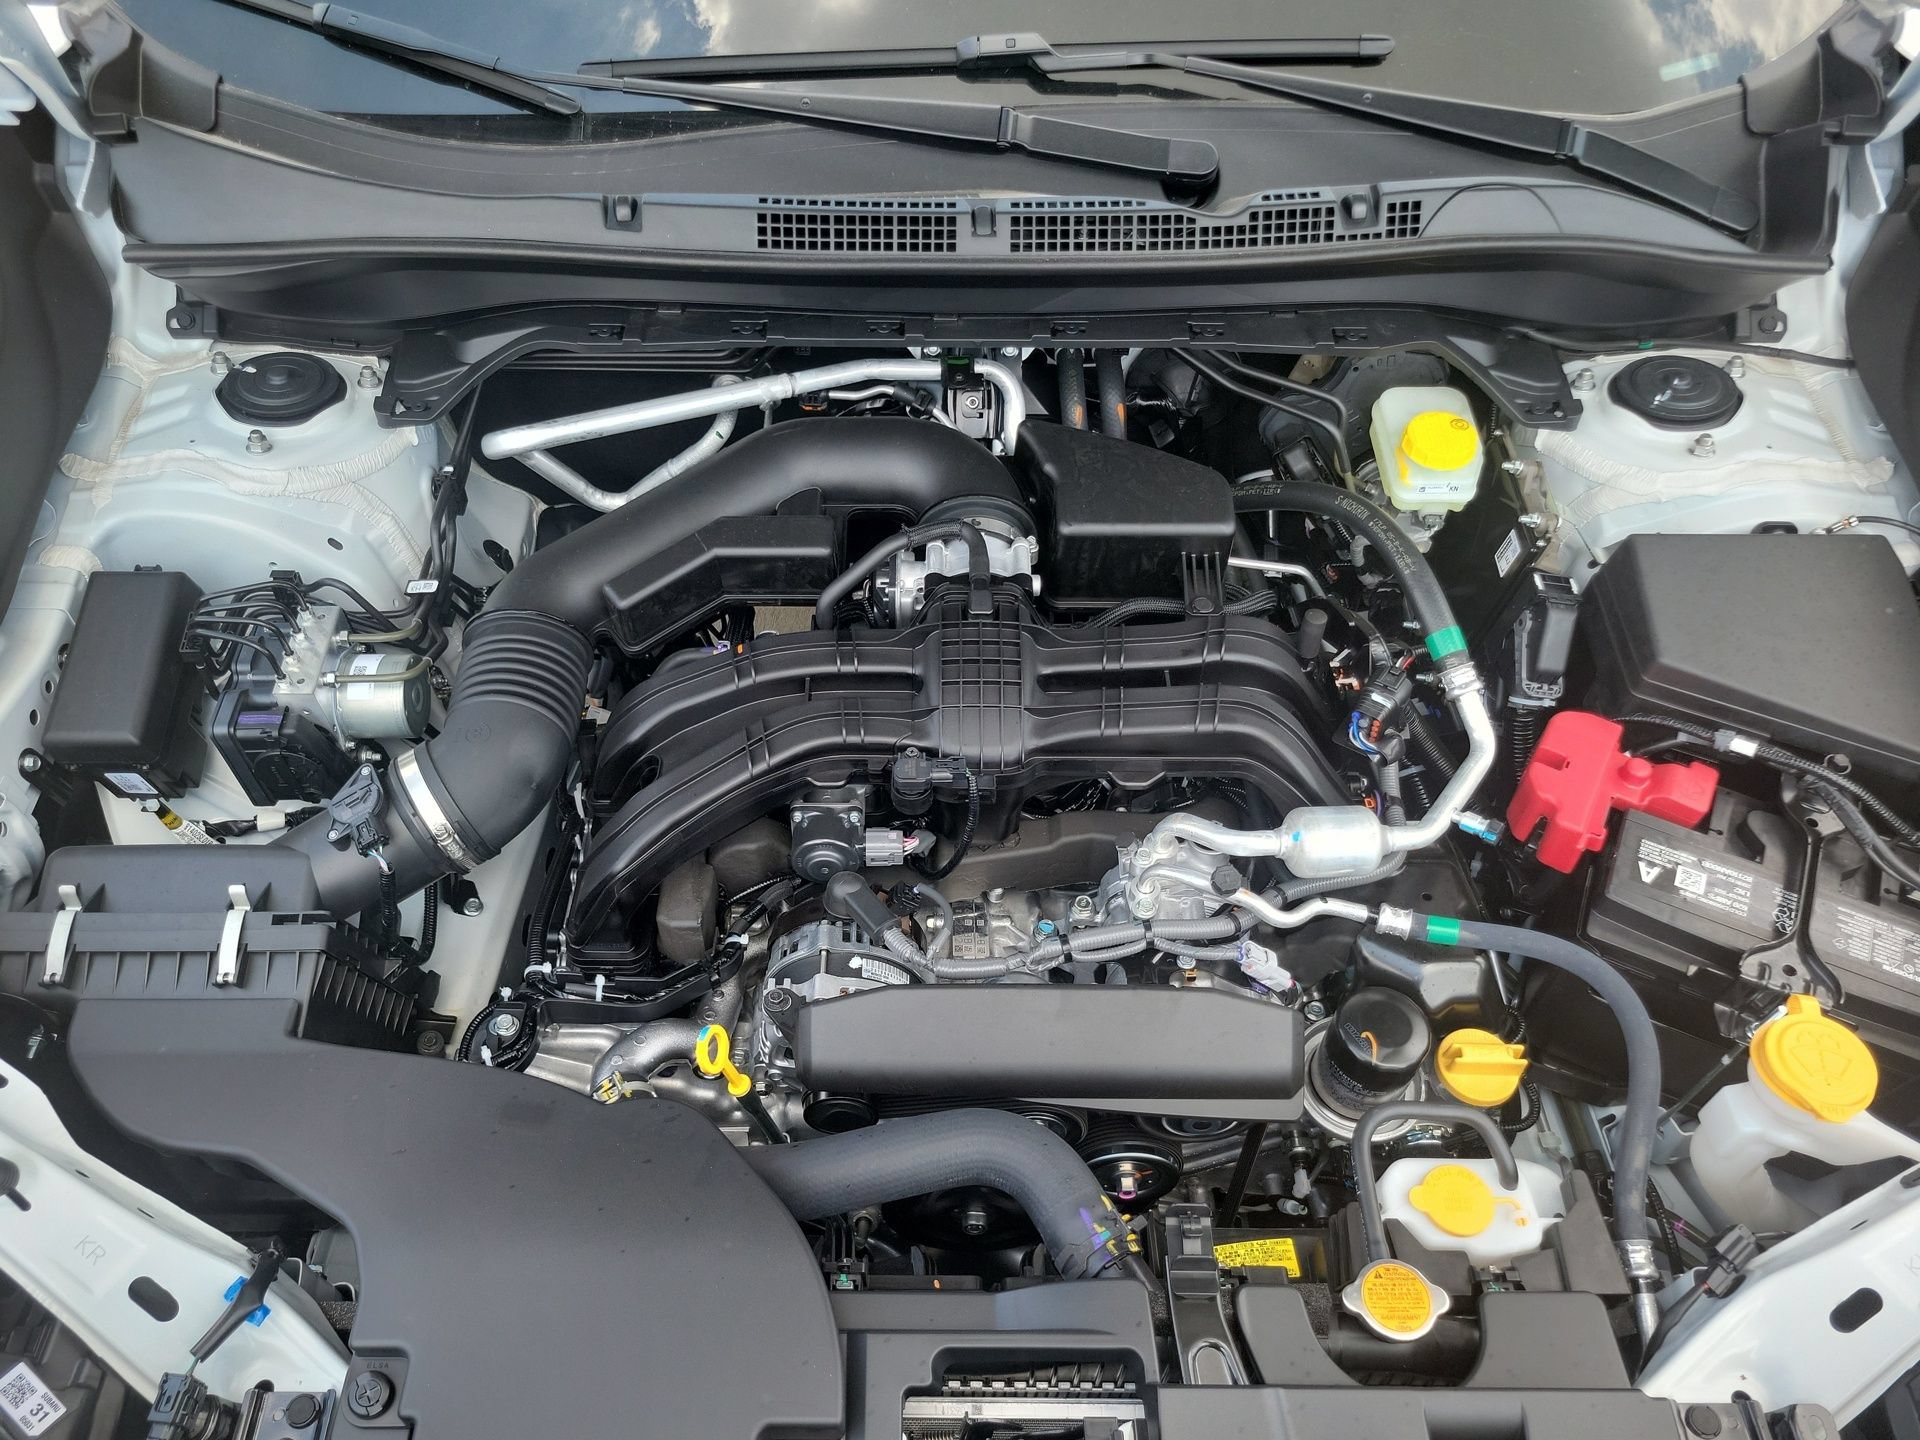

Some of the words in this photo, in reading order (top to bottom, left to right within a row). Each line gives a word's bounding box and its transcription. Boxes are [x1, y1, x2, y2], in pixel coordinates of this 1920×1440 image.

[1334, 495, 1371, 521] S-NICHIRIN
[73, 1234, 107, 1267] KR
[29, 1403, 50, 1423] 31
[41, 1391, 62, 1413] SUBARU
